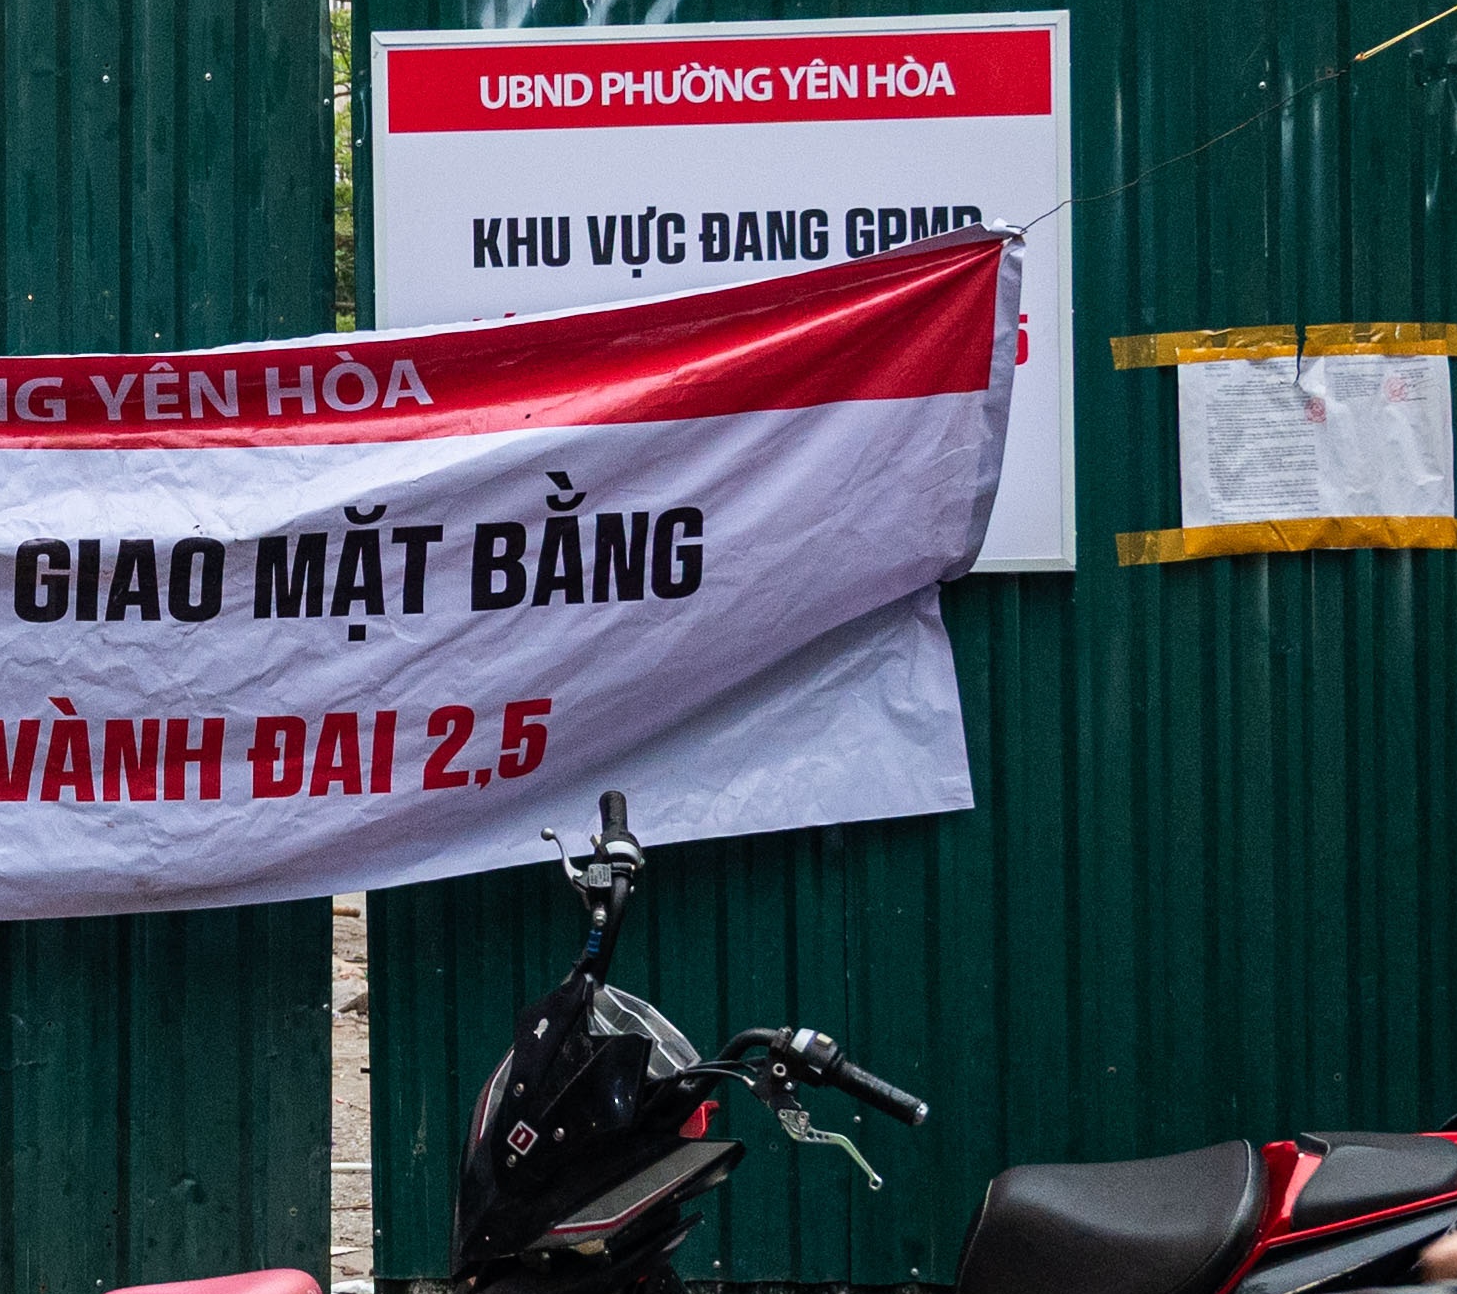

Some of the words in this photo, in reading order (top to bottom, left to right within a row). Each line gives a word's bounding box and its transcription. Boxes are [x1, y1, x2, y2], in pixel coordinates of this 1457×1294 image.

[480, 72, 593, 110] UBND
[601, 63, 773, 106] PHƯỜNG
[780, 59, 859, 101] YÊN
[867, 55, 956, 98] HÒA
[473, 216, 571, 268] KHU
[587, 207, 686, 279] VỰC
[699, 209, 829, 263] ĐANG
[88, 359, 240, 421] YÊN
[264, 349, 435, 416] HÒA
[11, 535, 228, 625] GIAO
[252, 502, 445, 643] MẶT
[469, 469, 706, 613] BẰNG
[251, 710, 396, 800] ĐAI
[422, 699, 551, 791] 2,5
